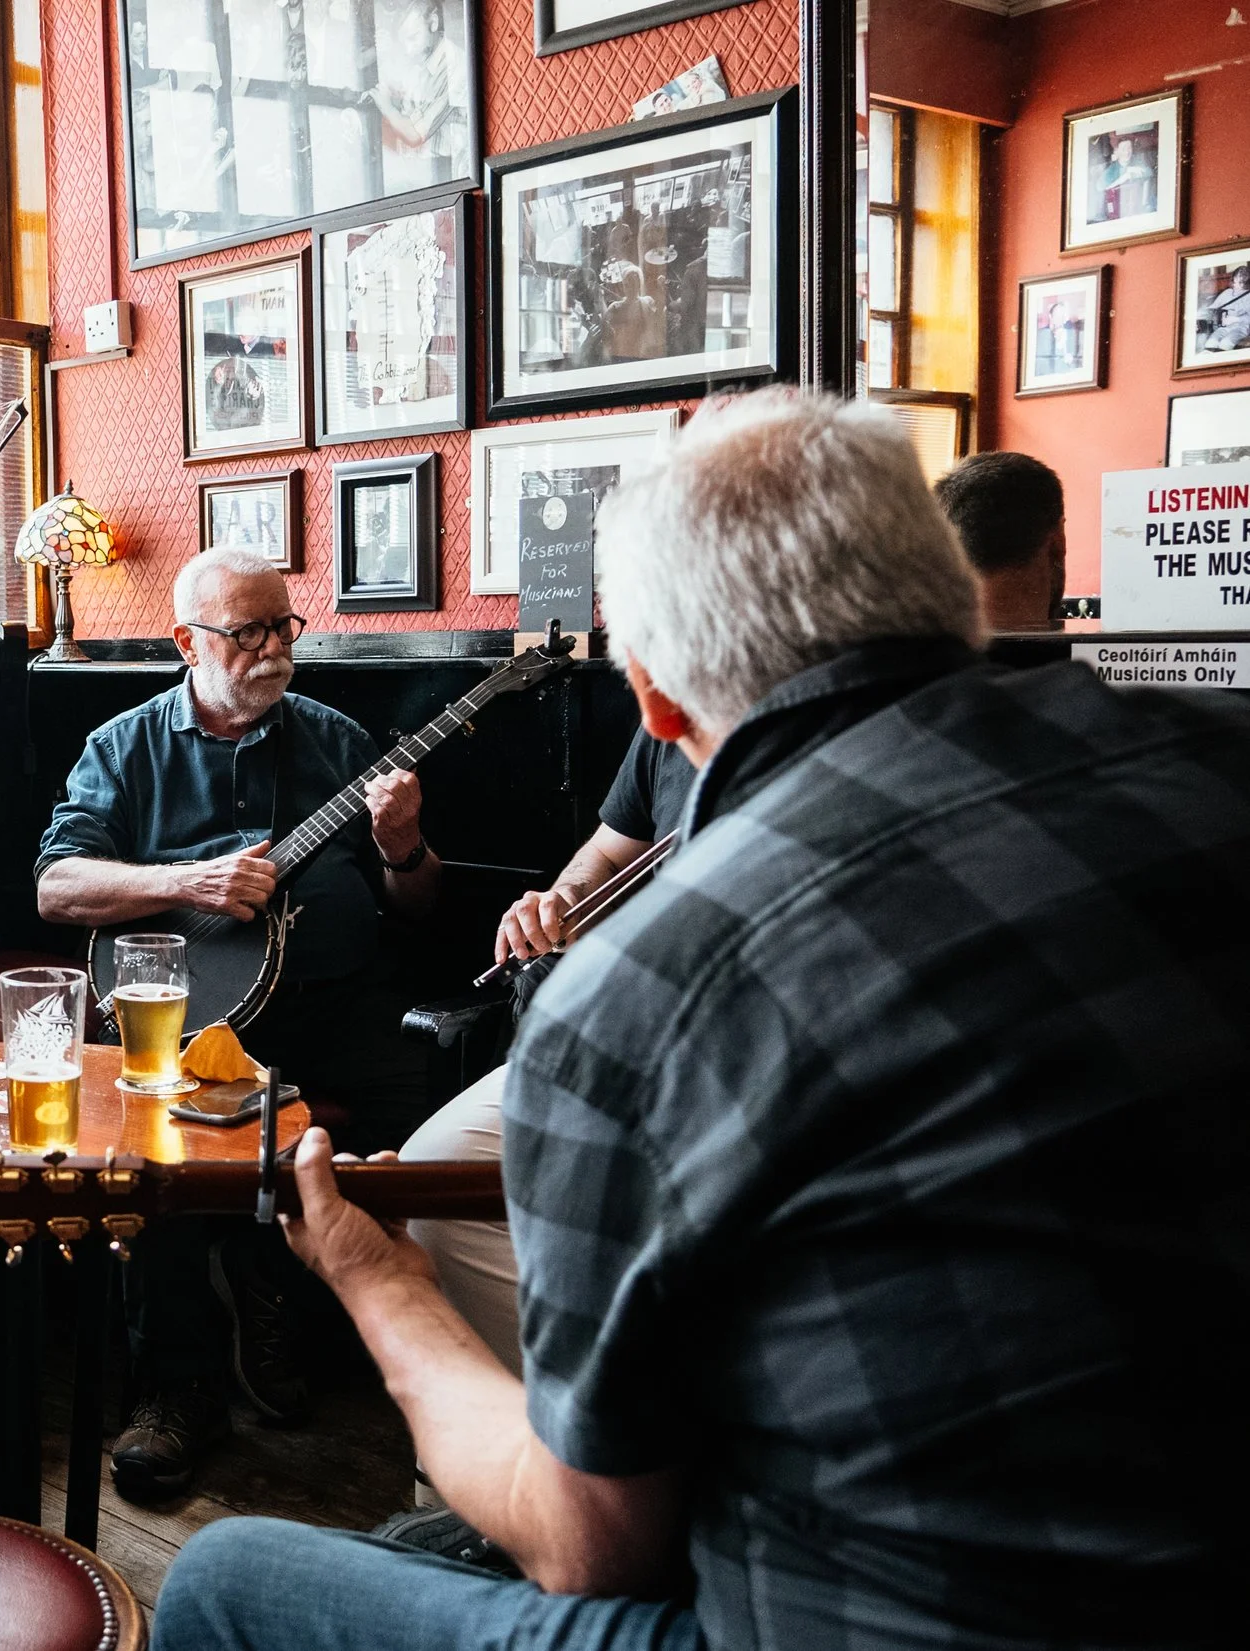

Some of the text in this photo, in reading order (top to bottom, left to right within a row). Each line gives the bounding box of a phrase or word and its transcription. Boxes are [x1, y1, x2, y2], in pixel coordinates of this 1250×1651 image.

[1148, 484, 1250, 513] LISTENIN
[1146, 520, 1231, 546] PLEASE
[521, 537, 590, 562] RESERVED
[541, 563, 567, 581] FOR
[1154, 553, 1197, 577] THE
[1098, 648, 1237, 663] Ceoltóirí Amháin
[1097, 666, 1237, 685] Musicians Only
